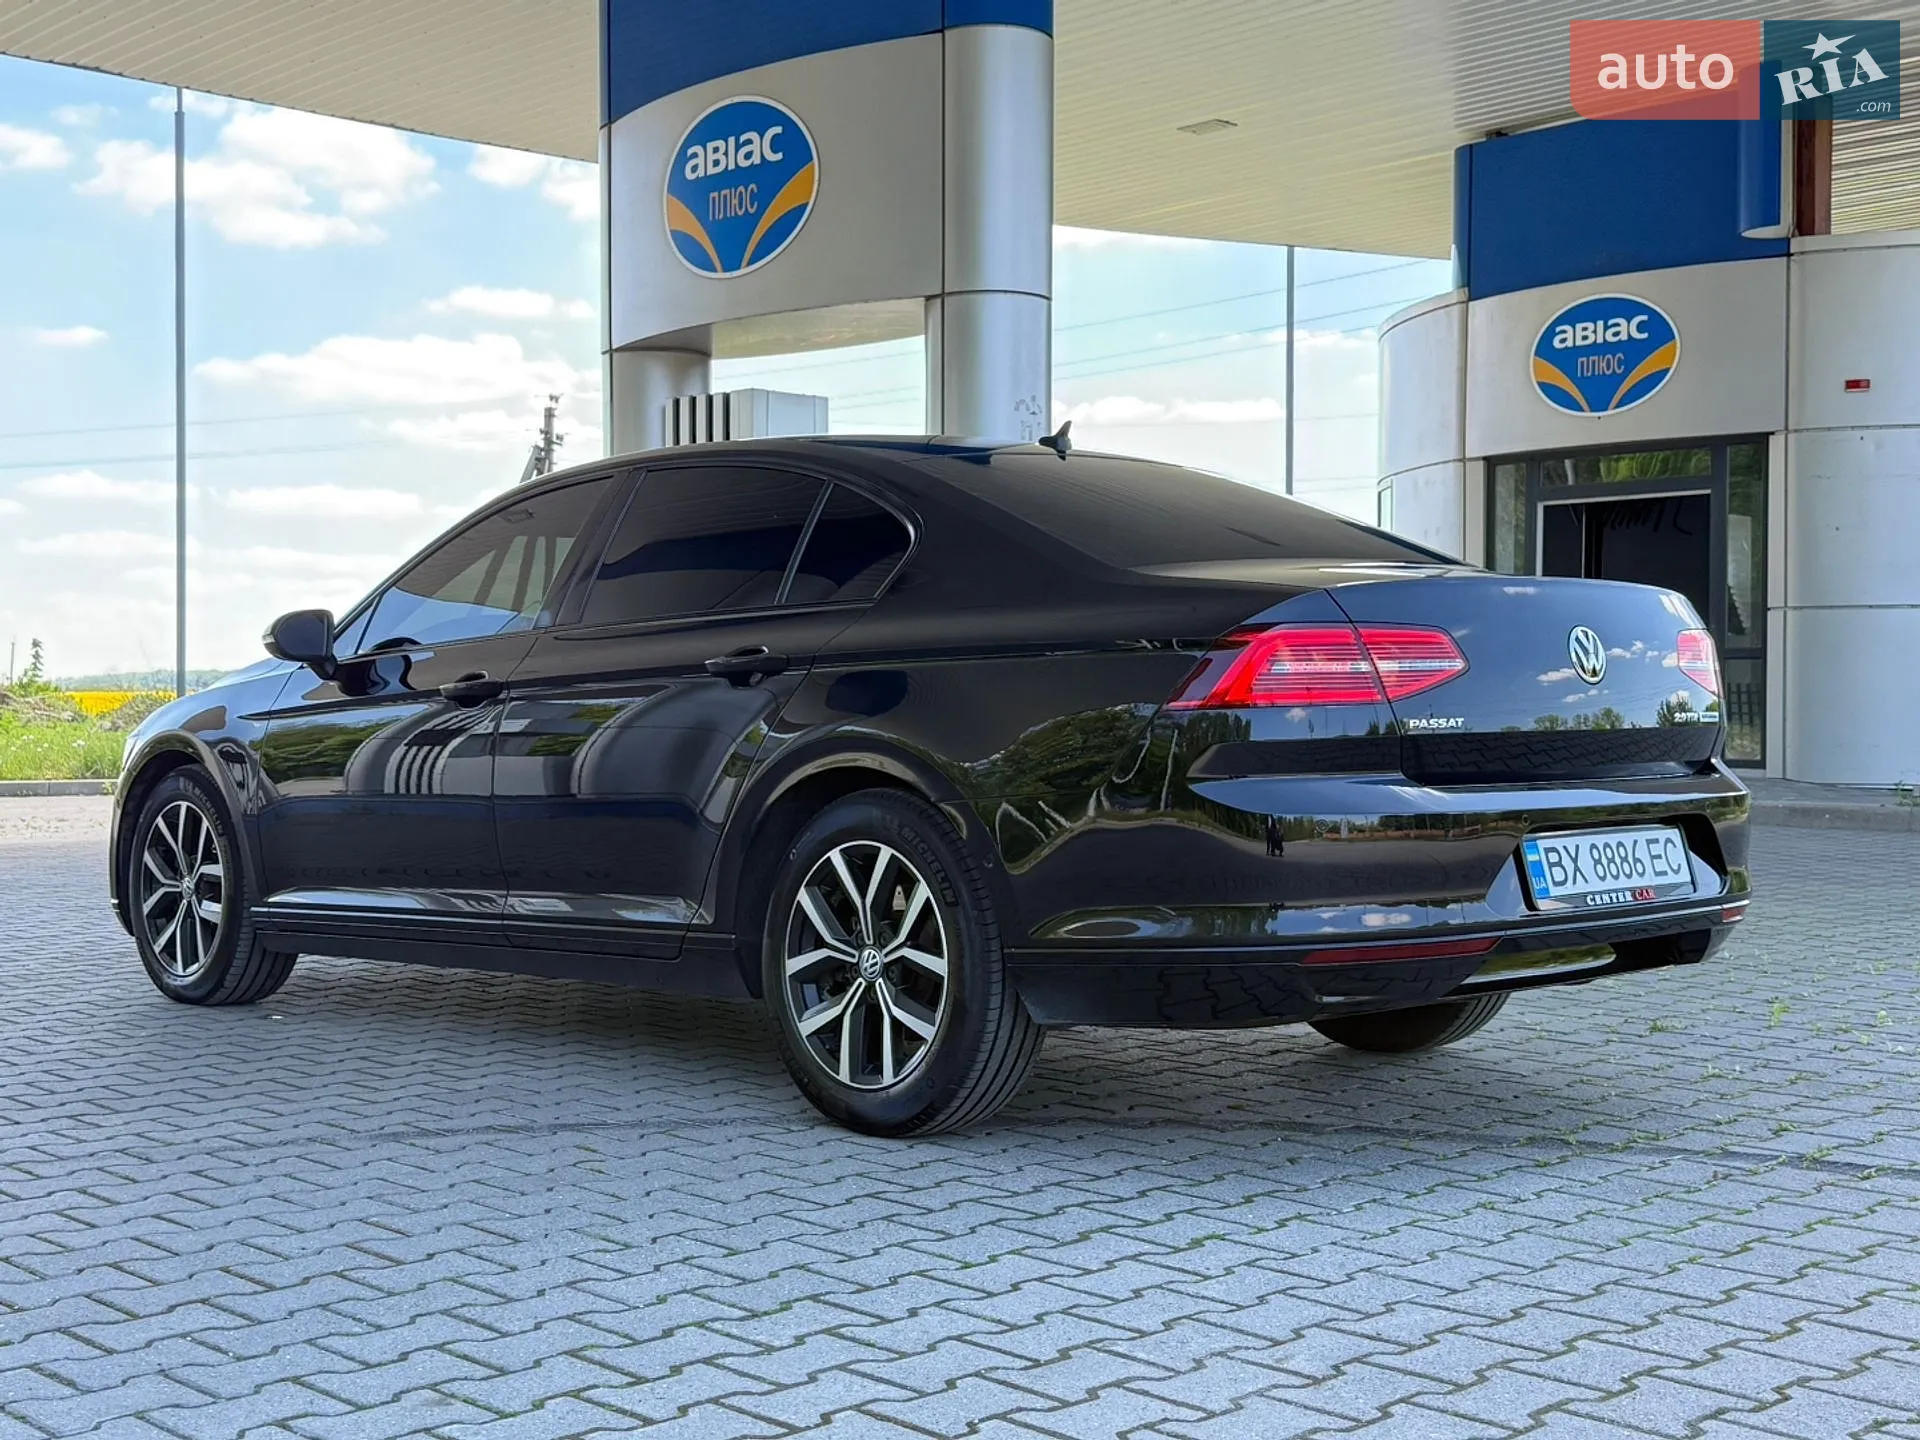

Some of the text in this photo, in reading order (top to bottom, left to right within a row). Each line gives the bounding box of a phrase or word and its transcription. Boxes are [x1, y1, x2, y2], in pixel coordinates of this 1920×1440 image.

[709, 183, 758, 221] ПЛЮС
[1577, 353, 1625, 377] ПЛЮС
[1409, 718, 1465, 728] PASSAT
[1543, 837, 1682, 887] BX 8886 EC
[1533, 876, 1546, 890] UA
[1586, 888, 1656, 905] CENTER CAR
